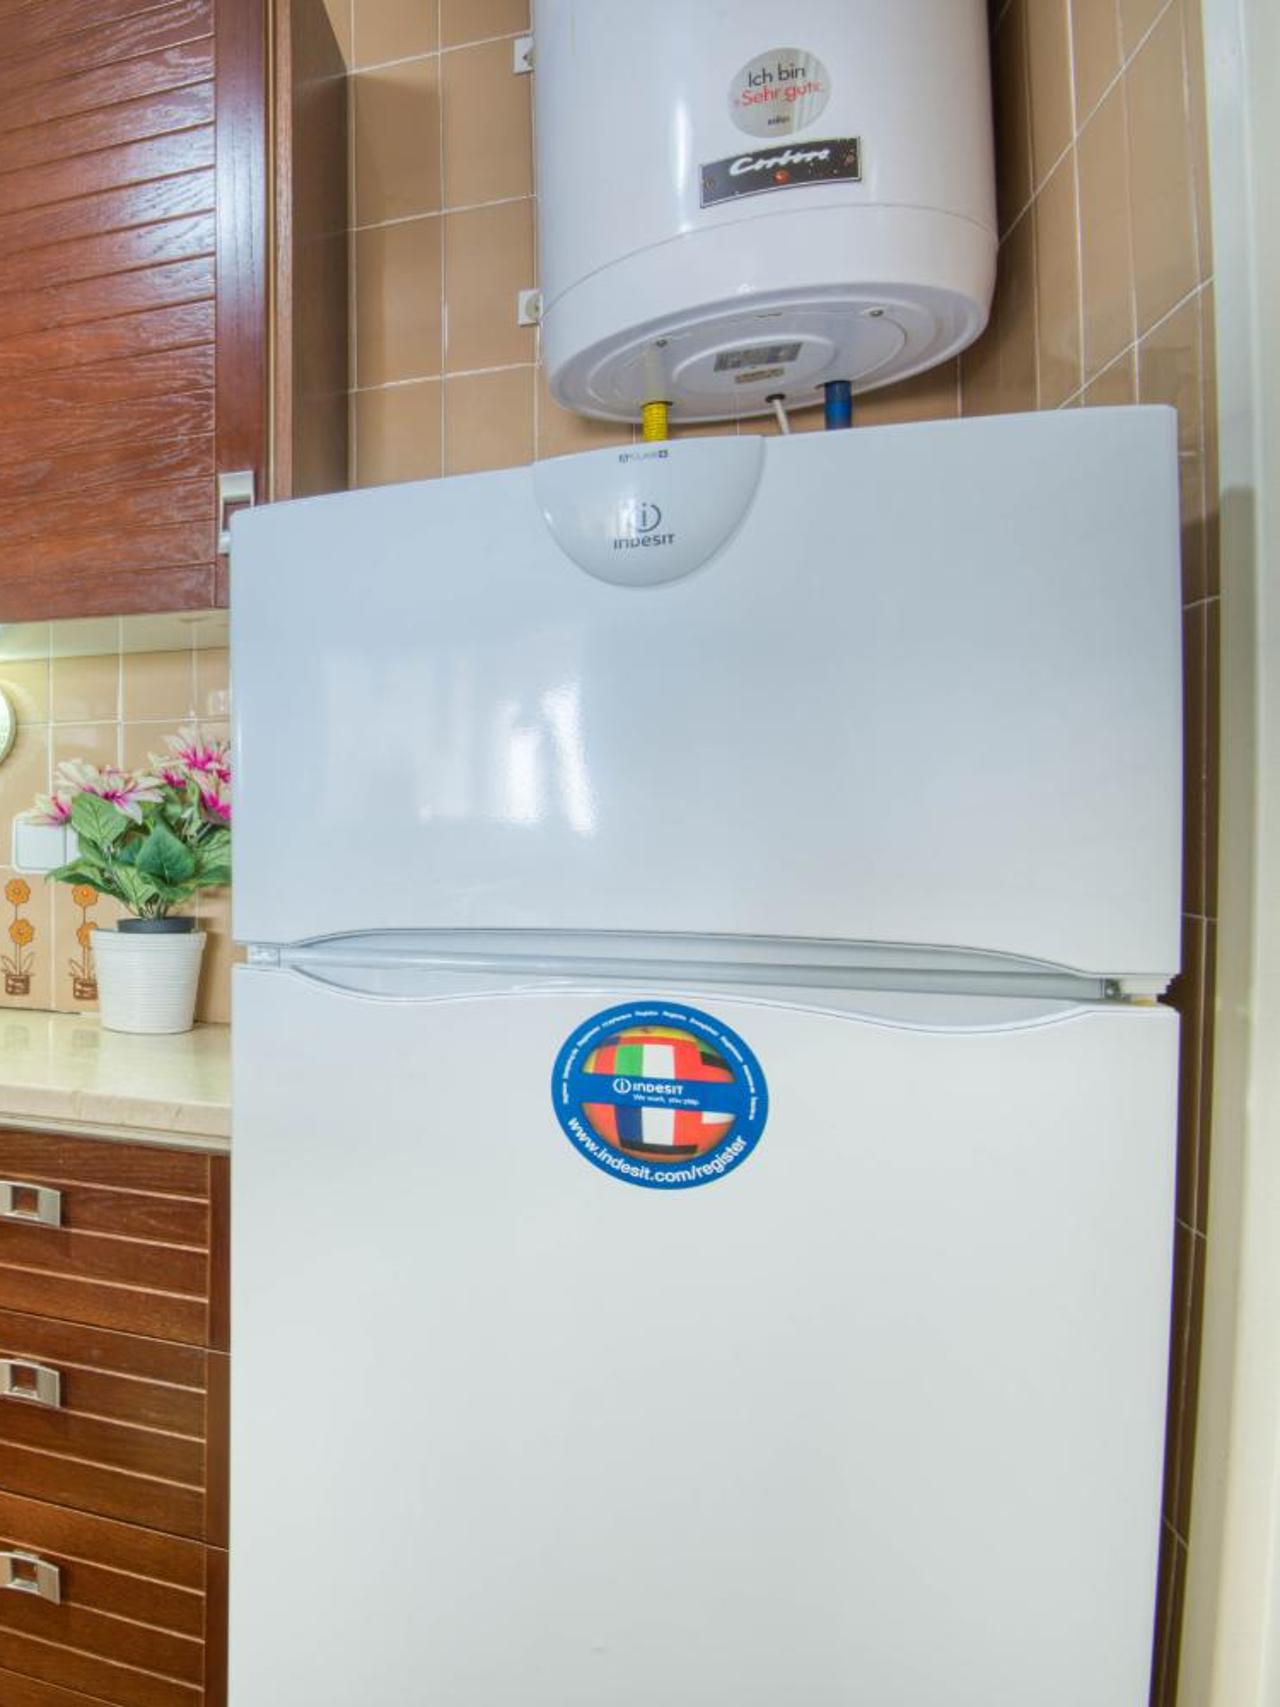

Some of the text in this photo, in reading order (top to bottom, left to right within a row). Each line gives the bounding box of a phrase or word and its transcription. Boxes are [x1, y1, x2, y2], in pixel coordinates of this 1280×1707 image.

[748, 62, 806, 88] Ich bin
[567, 1117, 747, 1183] www.indesit.com/register
